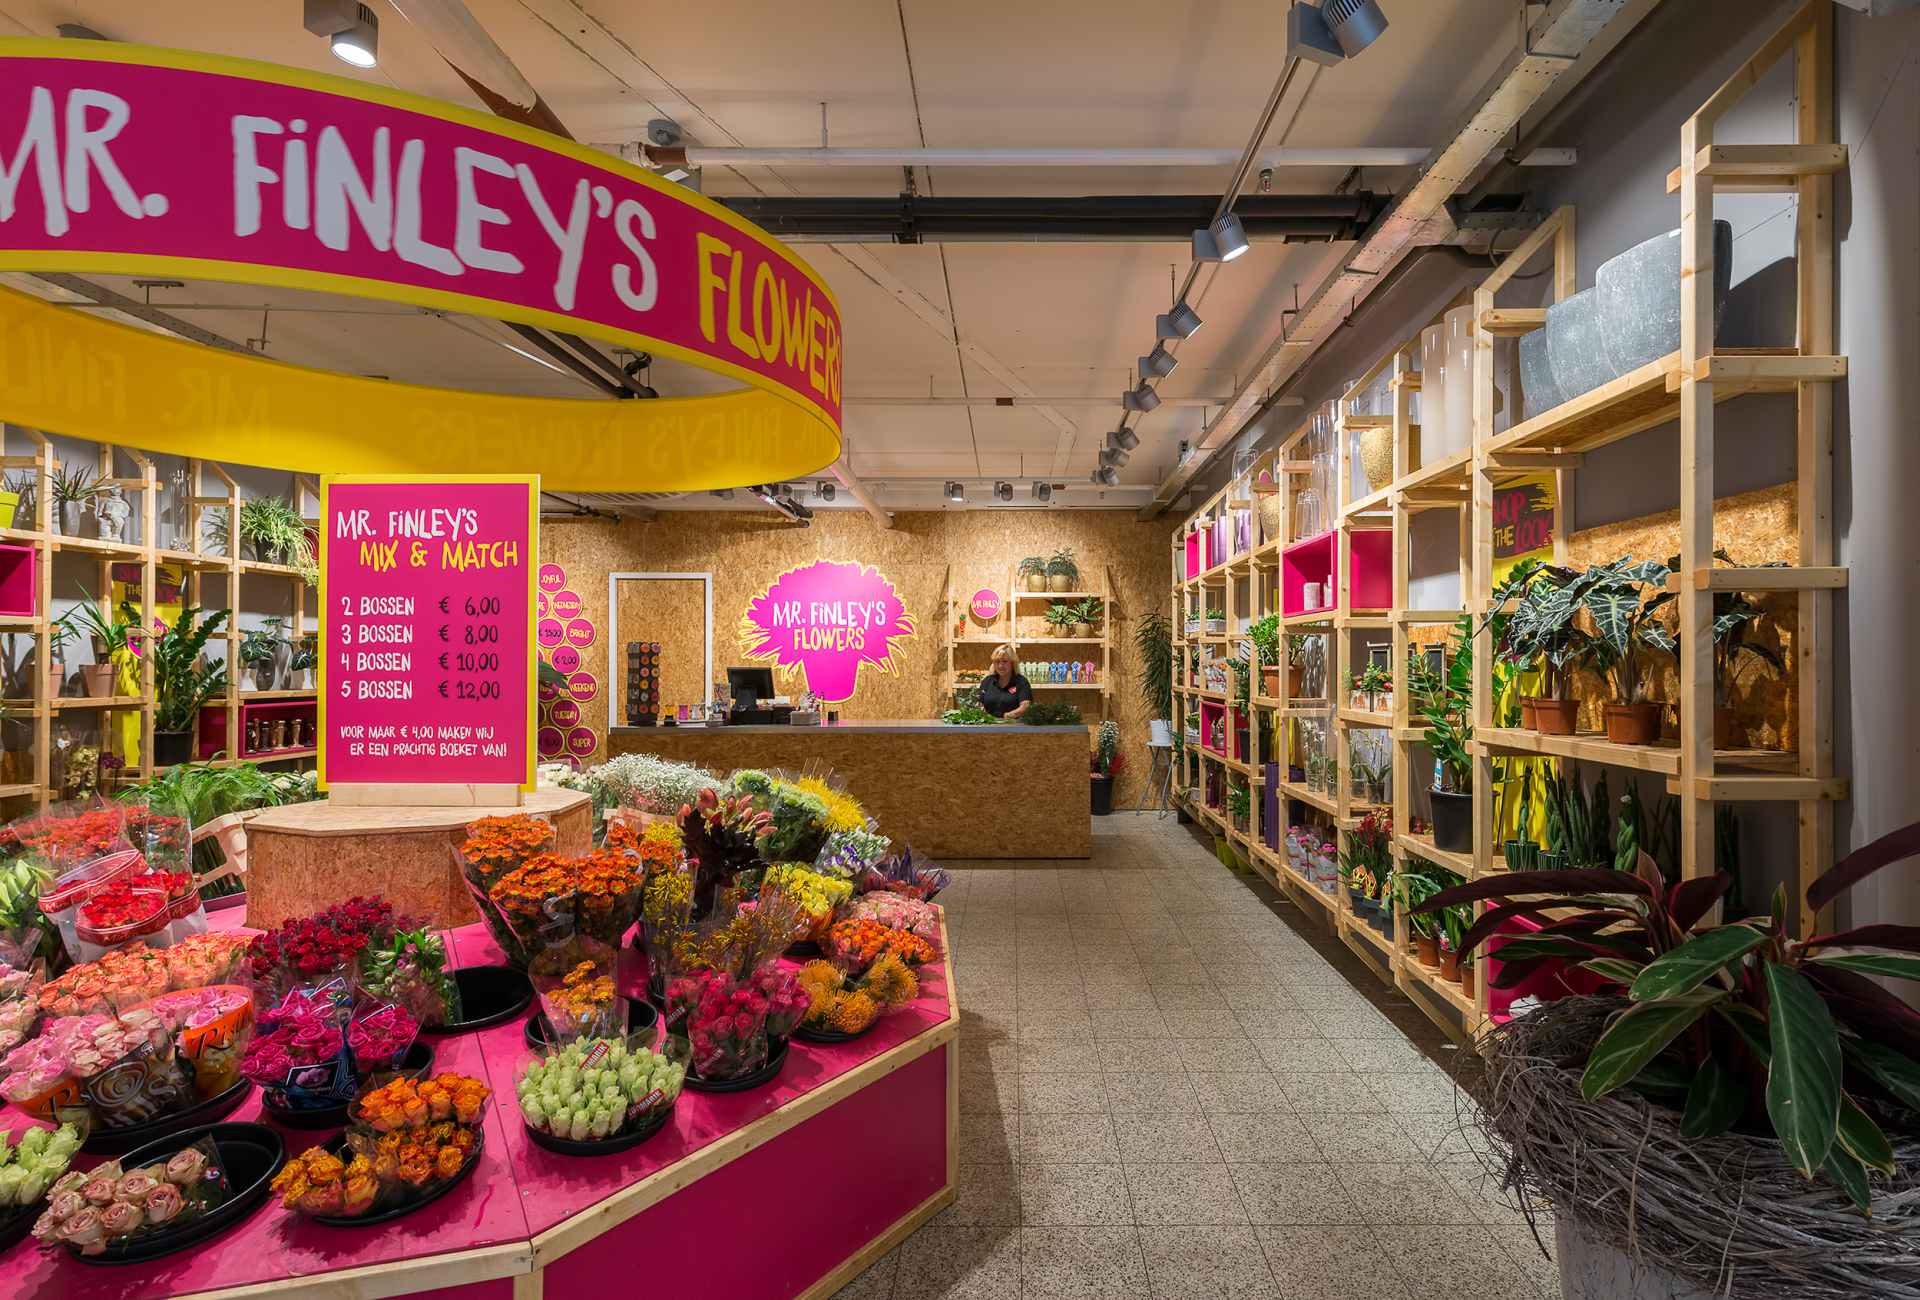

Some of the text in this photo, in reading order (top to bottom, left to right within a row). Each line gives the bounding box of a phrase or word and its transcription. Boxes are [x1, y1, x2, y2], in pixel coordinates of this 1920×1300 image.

[696, 231, 841, 408] FLOWERS
[336, 509, 377, 540] MR.
[1495, 514, 1553, 553] THE LOOK
[360, 539, 518, 573] MIX & MATCH
[540, 574, 561, 585] JOYFUL
[341, 596, 500, 617] 2 BOSSEN € 6,00
[773, 600, 806, 628] MR.
[341, 624, 498, 645] 3 BOSSEN € 8,00
[569, 628, 591, 639] BRIGHT
[794, 627, 865, 651] FLOWERS
[340, 652, 498, 674] 4 BOSSEN € 10,00
[555, 656, 577, 665] € 2,00
[340, 680, 500, 701] 5 BOSSEN € 12,00
[569, 683, 596, 692] WEEKEND
[554, 710, 577, 720] TUESDAY
[340, 725, 364, 739] VOOR
[368, 725, 396, 739] MAAR
[400, 725, 408, 738] €
[412, 726, 434, 740] 4,00
[438, 726, 472, 739] MAKEN
[572, 738, 591, 748] SUPER
[350, 743, 507, 757] ER EEN PRACHTIG BOEKET VAN!
